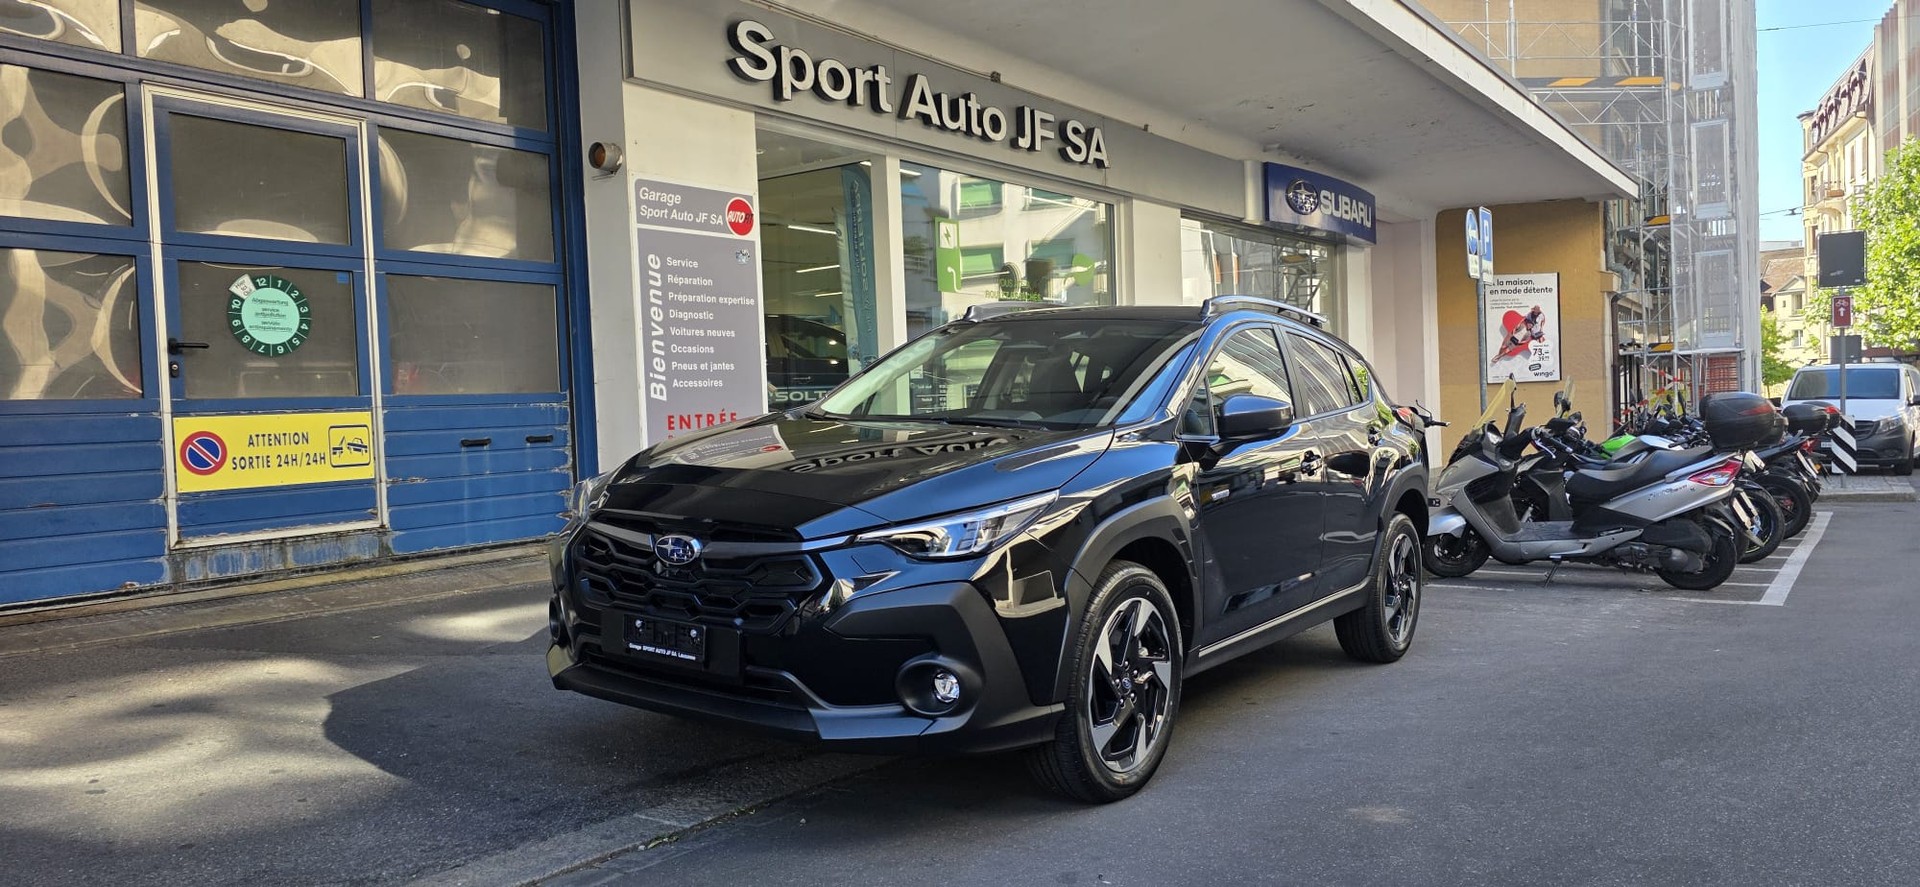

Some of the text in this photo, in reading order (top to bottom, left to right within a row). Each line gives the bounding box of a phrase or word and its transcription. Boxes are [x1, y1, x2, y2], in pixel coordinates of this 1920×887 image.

[730, 20, 1111, 169] Sport Auto JF SA
[639, 187, 682, 206] Garage
[1320, 190, 1372, 228] SUBARU
[640, 205, 724, 225] Sport Auto JF SA
[1483, 219, 1490, 256] P
[666, 257, 699, 268] Service
[255, 277, 268, 287] 12
[277, 280, 283, 288] 1
[667, 274, 713, 286] Réparation
[1505, 278, 1535, 286] maison,
[290, 290, 300, 299] 2
[1500, 287, 1522, 295] mode
[1523, 286, 1553, 294] détente
[231, 299, 241, 309] 10
[668, 292, 755, 306] Préparation expertise
[669, 309, 714, 321] Diagnostic
[232, 319, 241, 327] 9
[647, 254, 667, 402] Bienvenue
[669, 326, 736, 338] Voitures neuves
[241, 335, 251, 344] 8
[292, 337, 300, 346] 5
[257, 345, 265, 353] 7
[276, 345, 284, 354] 6
[670, 343, 715, 354] Occasions
[671, 361, 735, 372] Pneus et jantes
[672, 378, 723, 388] Accessoires
[775, 390, 827, 402] SOLT
[667, 408, 737, 431] ENTRÉE
[247, 432, 310, 448] ATTENTION
[232, 452, 326, 470] SORTIE 24H/24H
